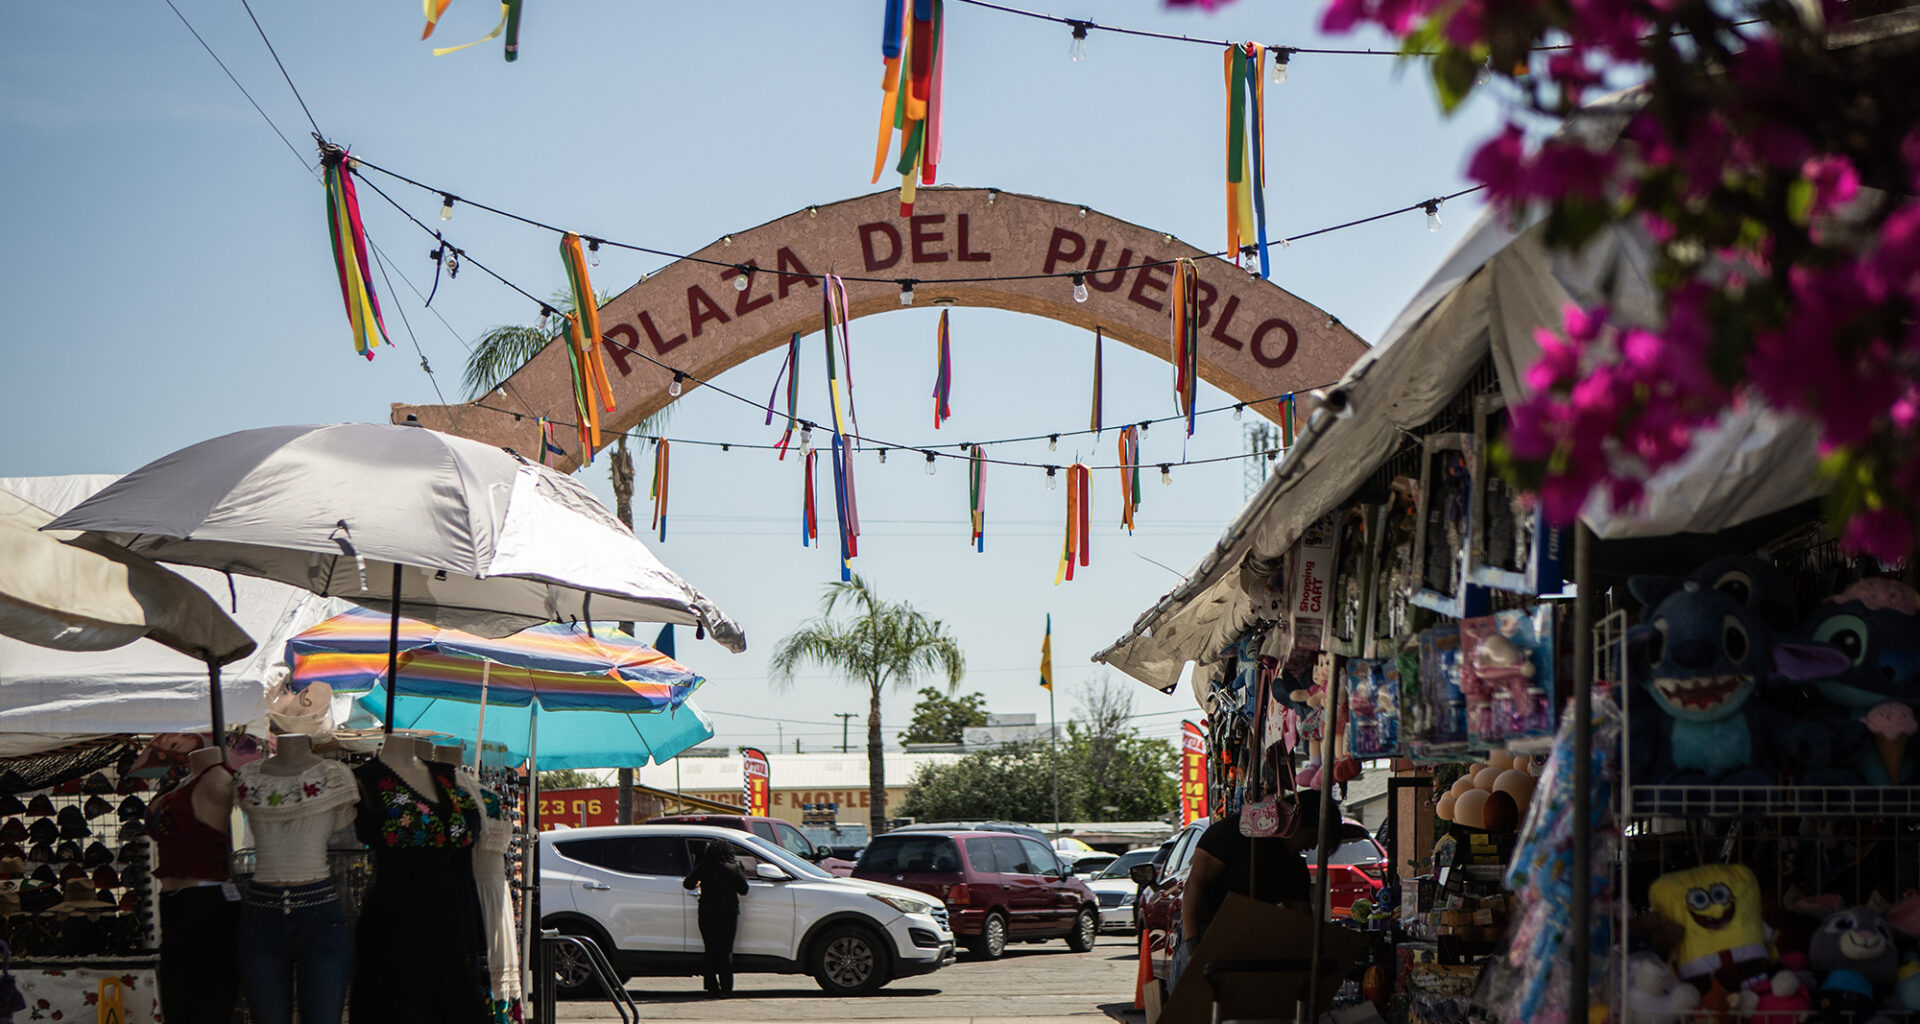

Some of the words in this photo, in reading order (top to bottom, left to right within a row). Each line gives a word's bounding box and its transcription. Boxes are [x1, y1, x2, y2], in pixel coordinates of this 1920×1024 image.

[601, 246, 819, 377] PLAZA
[858, 213, 992, 272] DEL
[1299, 561, 1316, 612] Shopping
[1311, 577, 1323, 613] CART
